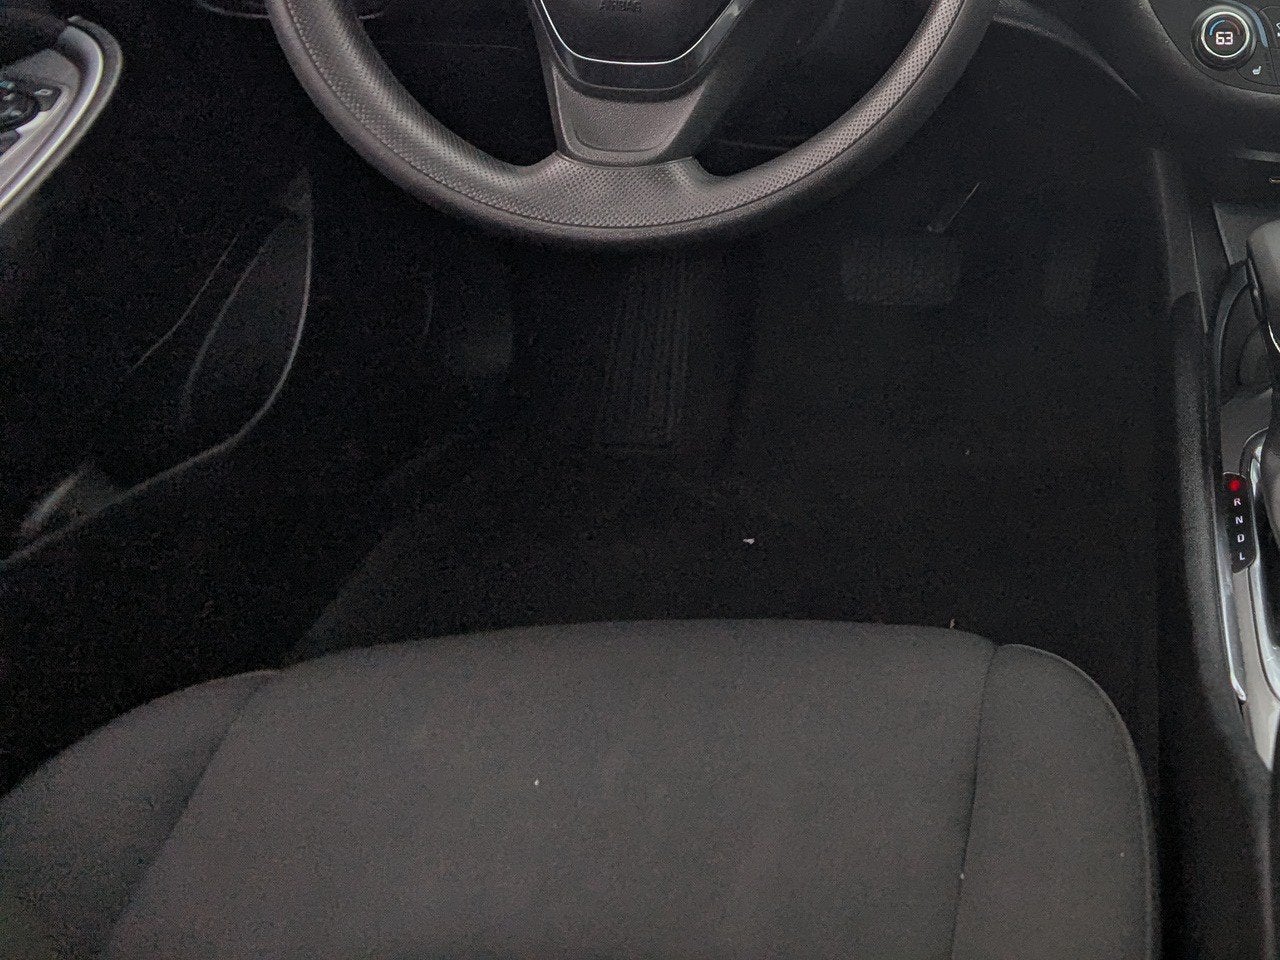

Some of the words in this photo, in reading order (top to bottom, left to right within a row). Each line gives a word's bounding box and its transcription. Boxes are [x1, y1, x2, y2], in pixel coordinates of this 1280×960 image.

[1215, 31, 1234, 46] 63
[1233, 497, 1242, 507] R
[1235, 515, 1244, 525] N
[1236, 533, 1246, 543] D
[1239, 551, 1246, 561] L
